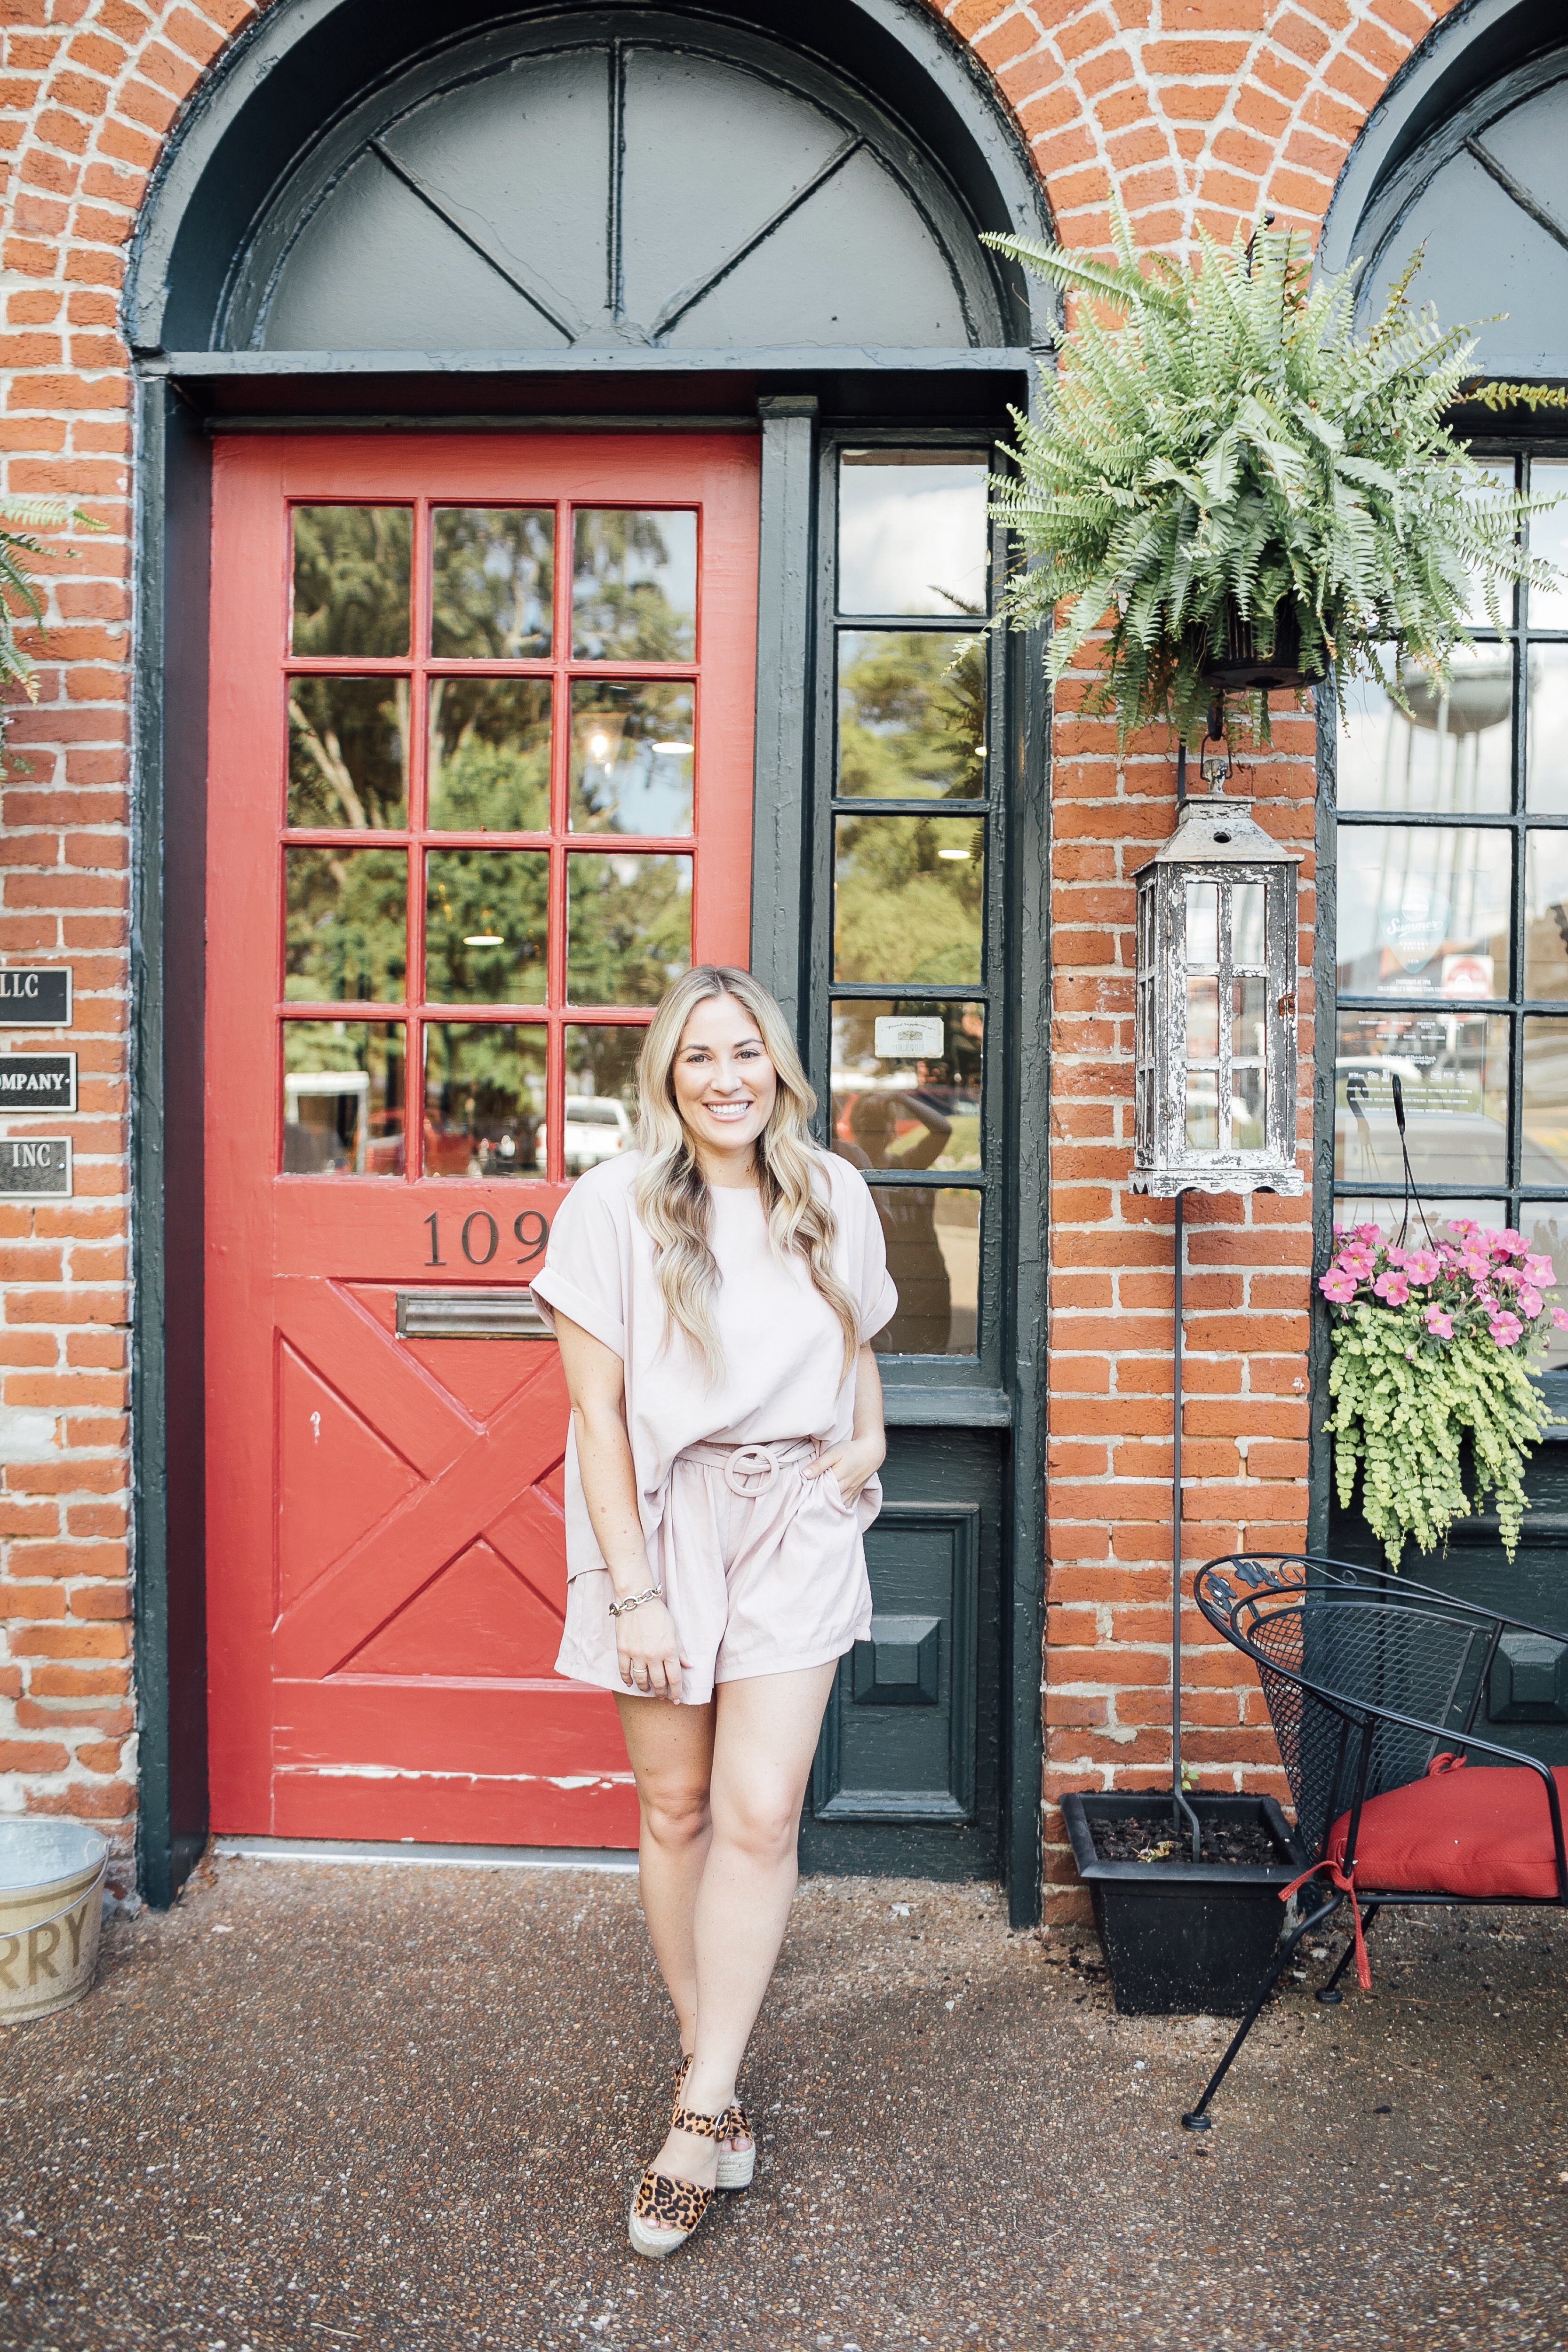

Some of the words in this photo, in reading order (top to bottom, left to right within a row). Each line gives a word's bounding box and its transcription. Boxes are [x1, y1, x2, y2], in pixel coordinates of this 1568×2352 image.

[1386, 917, 1443, 937] Summer
[0, 973, 38, 998] LLC
[0, 1073, 65, 1090] MPANY
[12, 1143, 51, 1167] INC
[423, 1210, 549, 1266] 109
